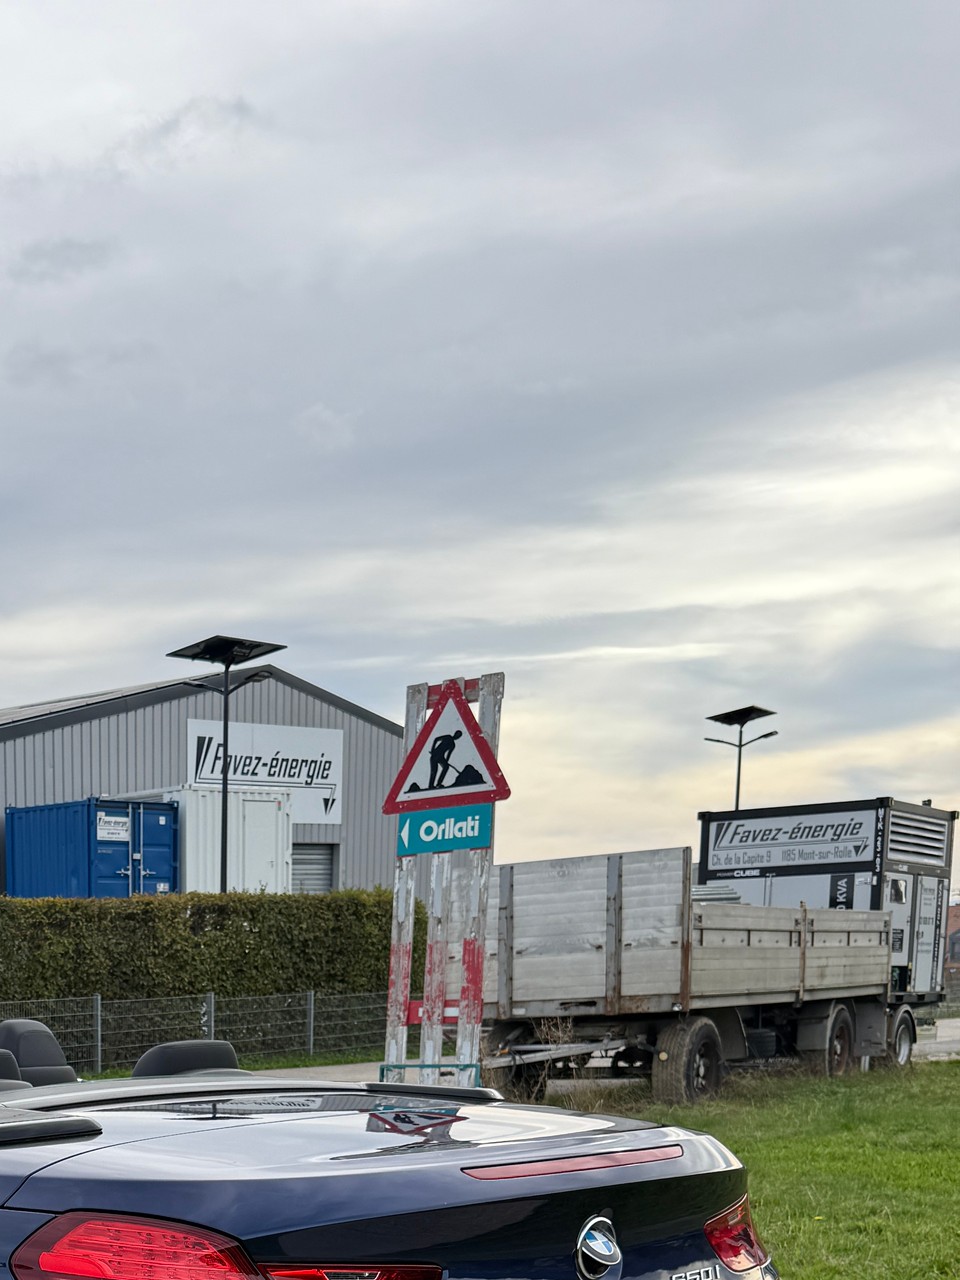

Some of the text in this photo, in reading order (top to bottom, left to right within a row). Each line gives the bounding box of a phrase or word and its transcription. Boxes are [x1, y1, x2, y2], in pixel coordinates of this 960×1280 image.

[419, 815, 480, 842] Orllati
[729, 818, 863, 844] Favez-énergie
[724, 853, 733, 866] de
[734, 852, 741, 865] la
[742, 851, 765, 866] Capite
[766, 850, 771, 863] 9
[798, 846, 852, 861] Mont-sur-Rolle
[836, 878, 848, 902] KVA
